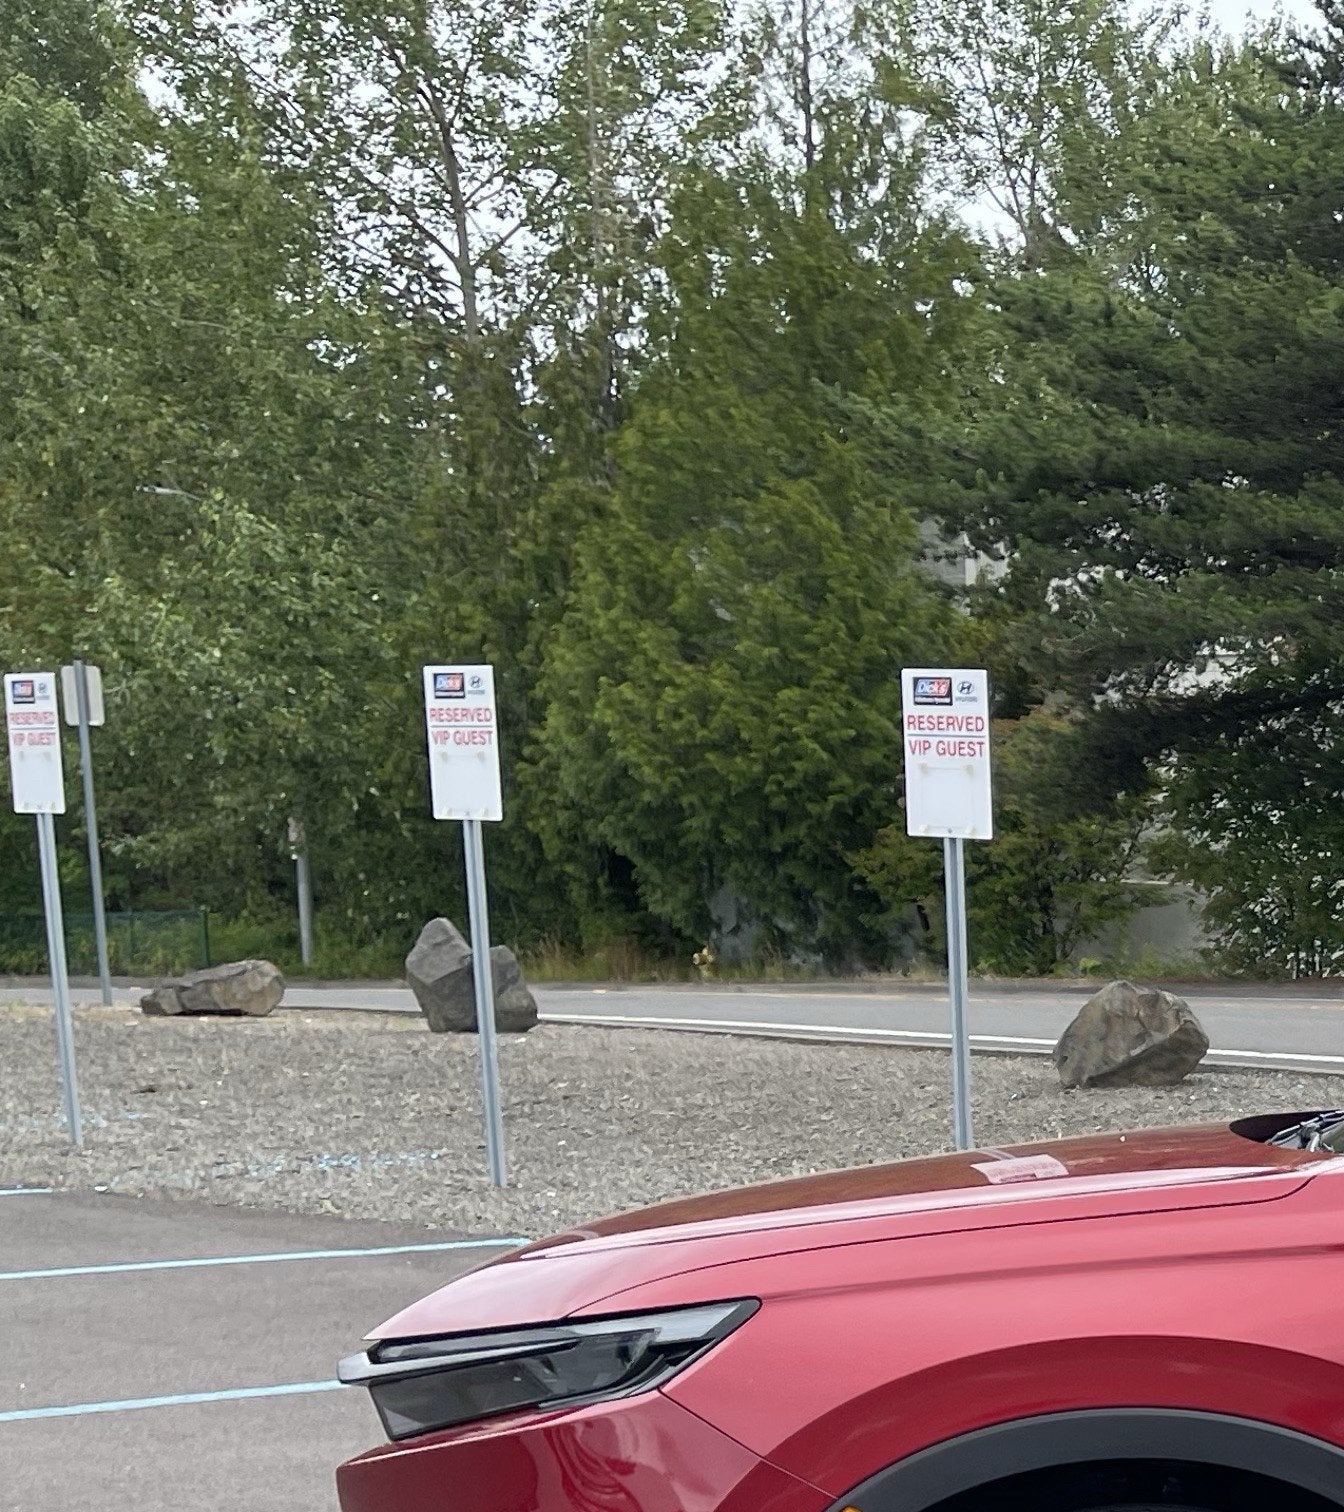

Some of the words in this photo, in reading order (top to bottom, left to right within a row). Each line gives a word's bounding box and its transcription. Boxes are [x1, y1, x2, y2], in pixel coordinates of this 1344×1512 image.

[429, 707, 492, 723] RESERVED
[907, 714, 984, 732] RESERVED
[431, 730, 450, 745] VIP
[453, 730, 493, 746] GUEST
[908, 740, 931, 755] VIP
[936, 740, 985, 757] GUEST
